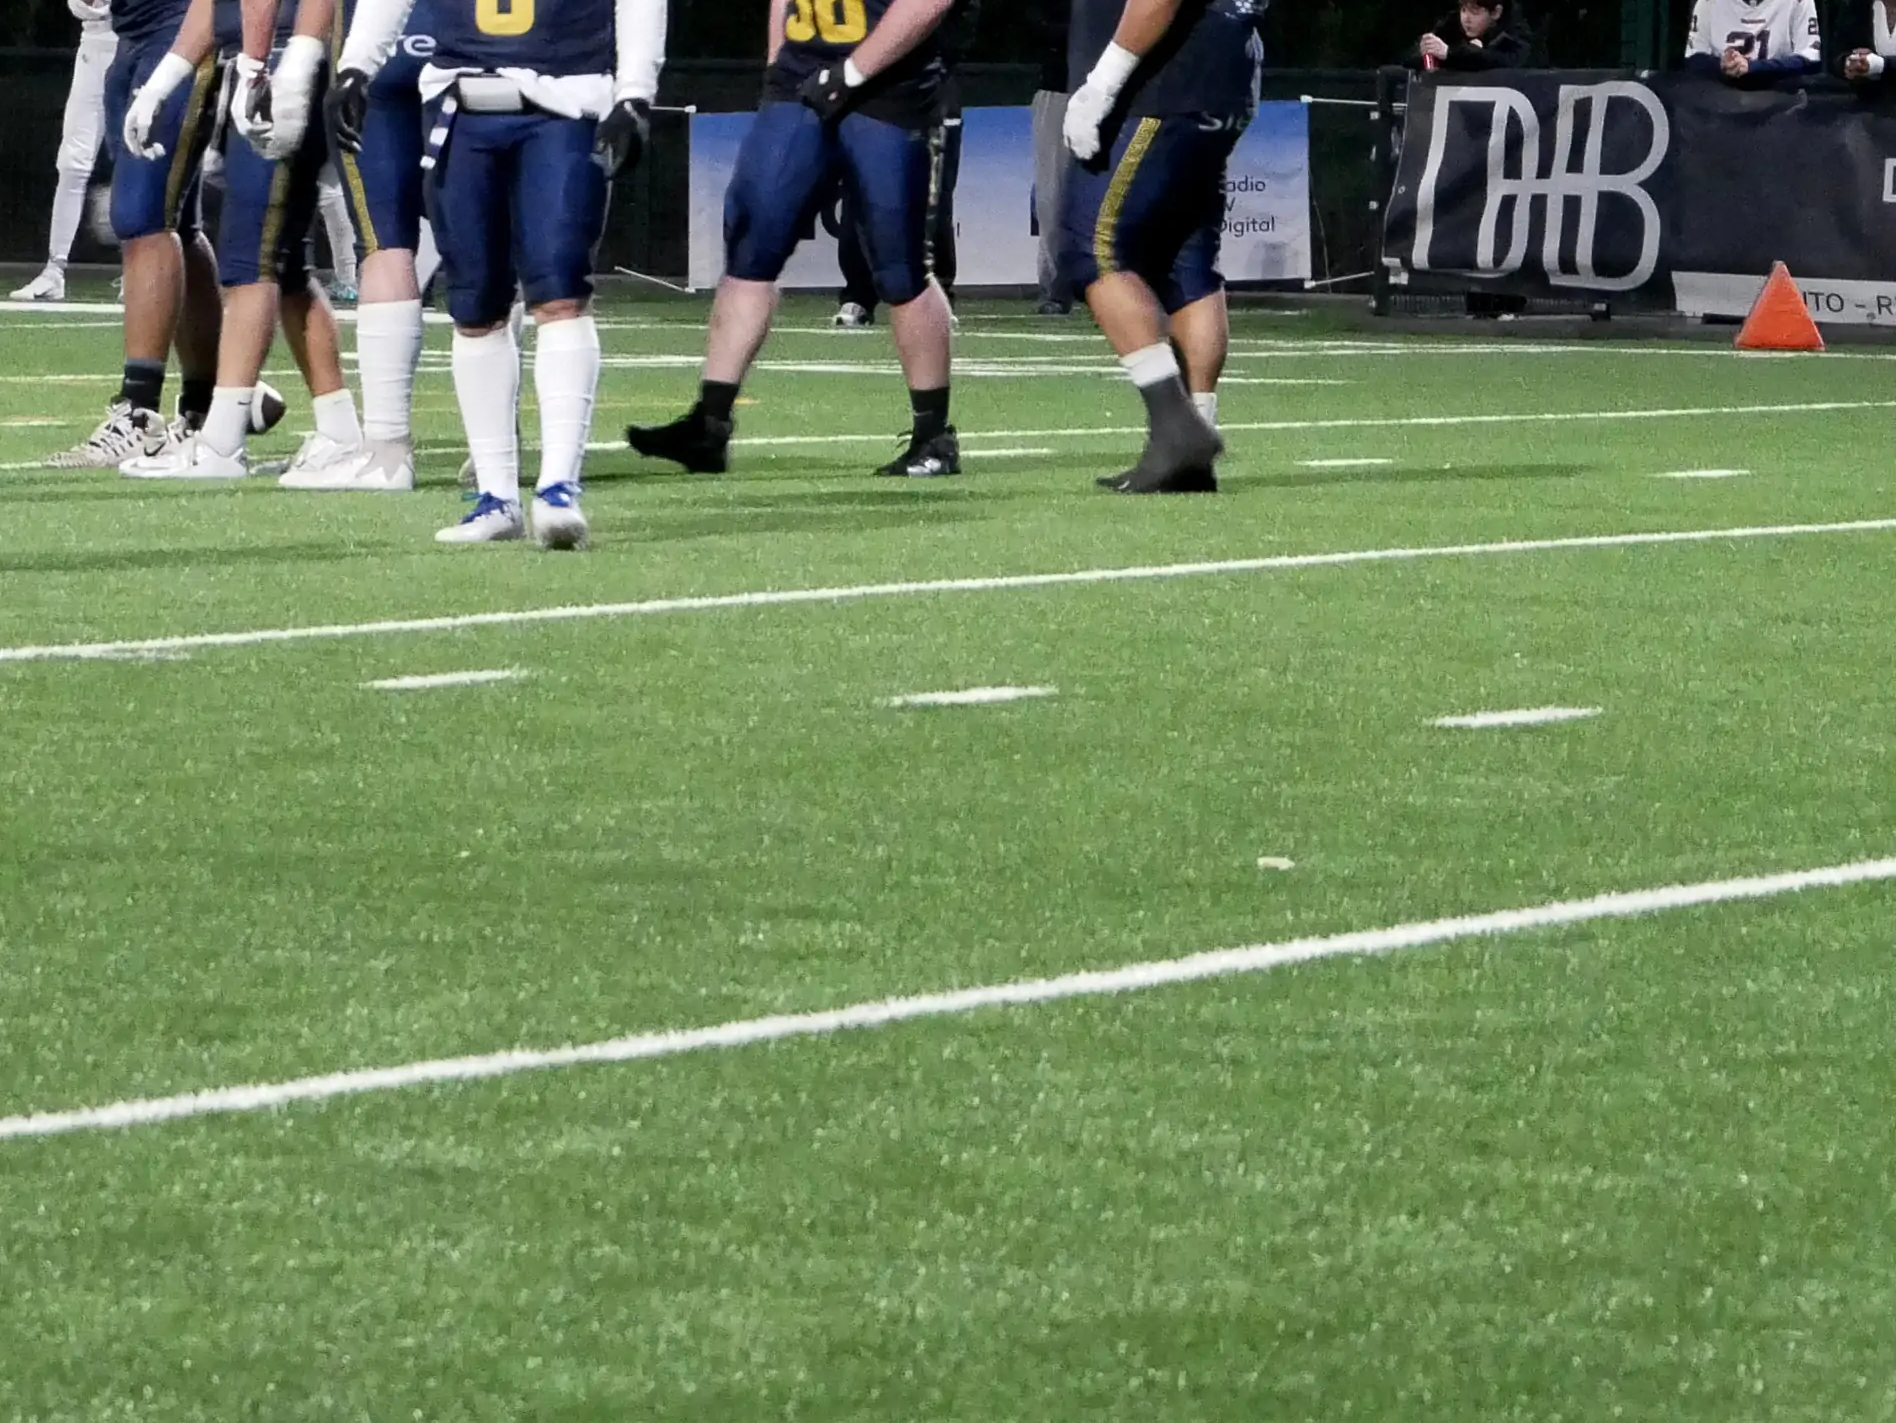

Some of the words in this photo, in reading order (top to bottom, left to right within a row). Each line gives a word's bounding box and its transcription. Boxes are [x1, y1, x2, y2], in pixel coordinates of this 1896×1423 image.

[1807, 17, 1820, 36] 2
[1225, 175, 1266, 192] adio
[1803, 291, 1844, 313] TO
[1877, 295, 1896, 315] R
